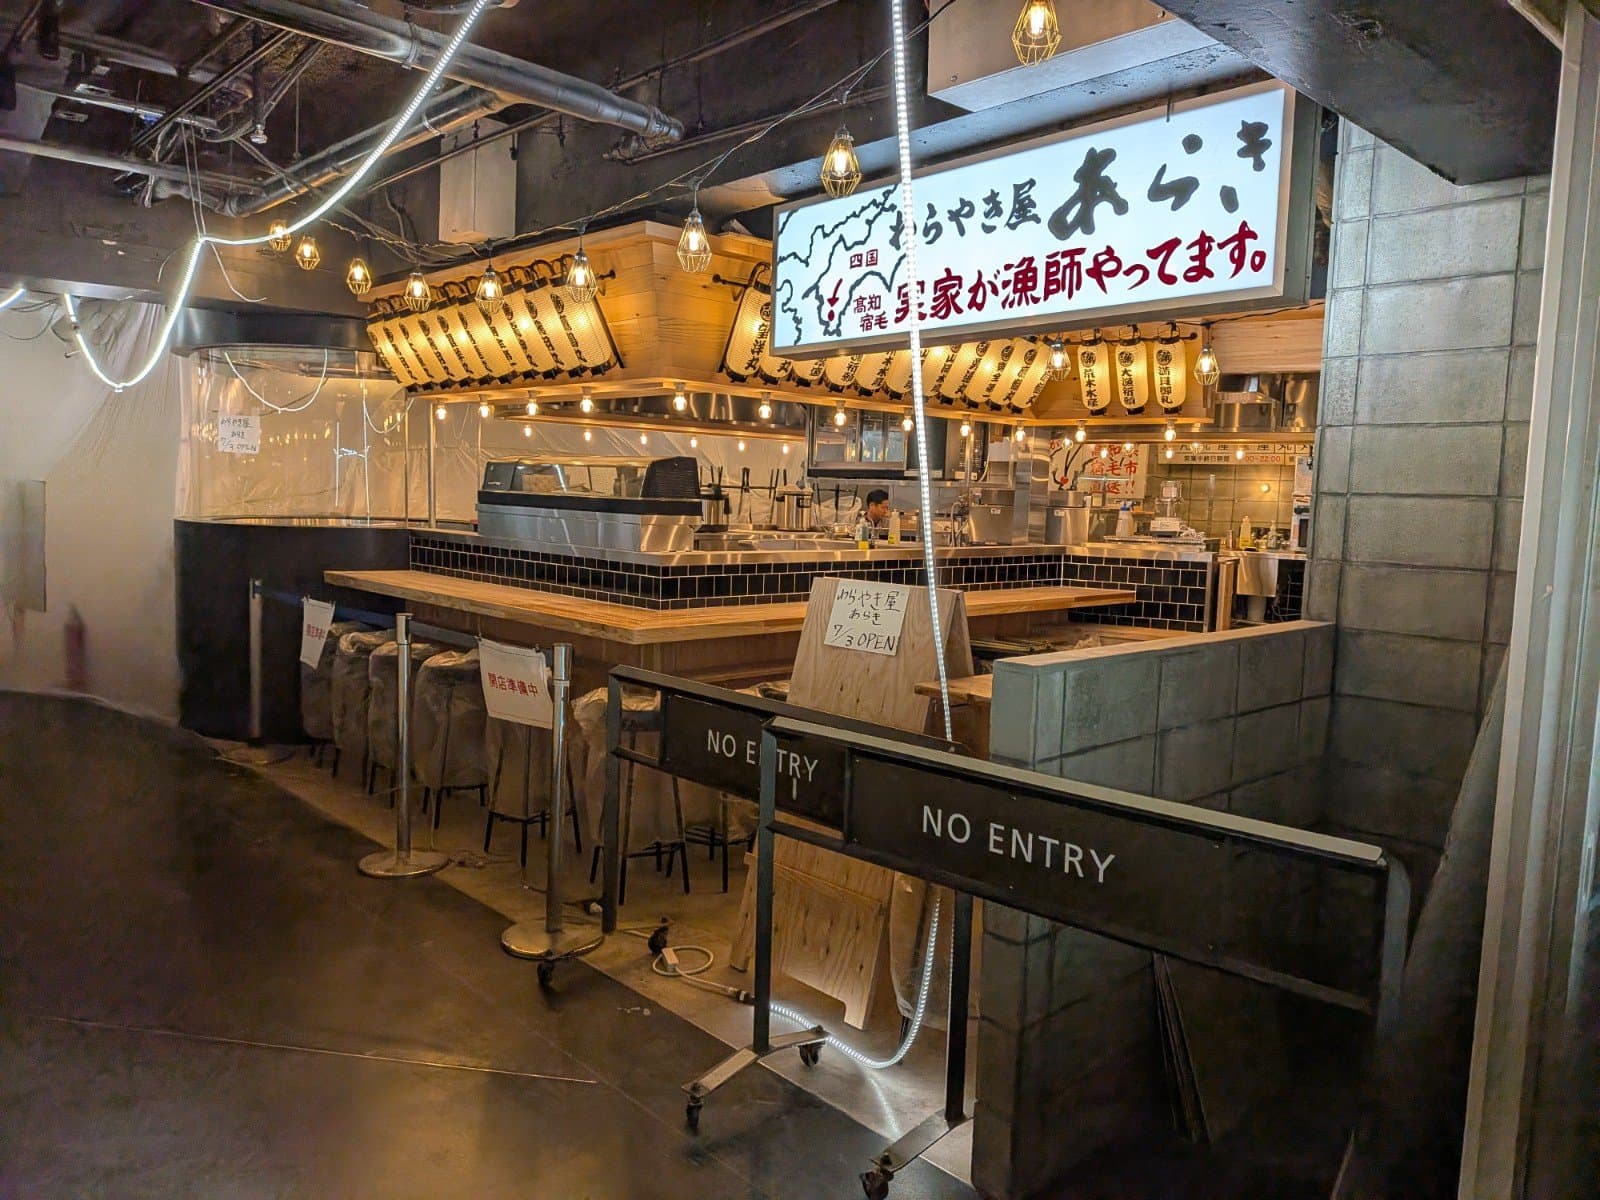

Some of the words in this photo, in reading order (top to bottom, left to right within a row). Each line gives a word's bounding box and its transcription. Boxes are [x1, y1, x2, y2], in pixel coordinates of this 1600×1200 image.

[849, 249, 878, 269] 四国
[860, 311, 888, 332] 宿毛
[837, 588, 901, 613] わらやき屋
[848, 608, 881, 626] あらき
[857, 632, 895, 651] OPEN
[707, 728, 737, 758] NO
[746, 740, 819, 783] ETRY
[922, 804, 971, 844] NO
[988, 822, 1116, 884] ENTRY
